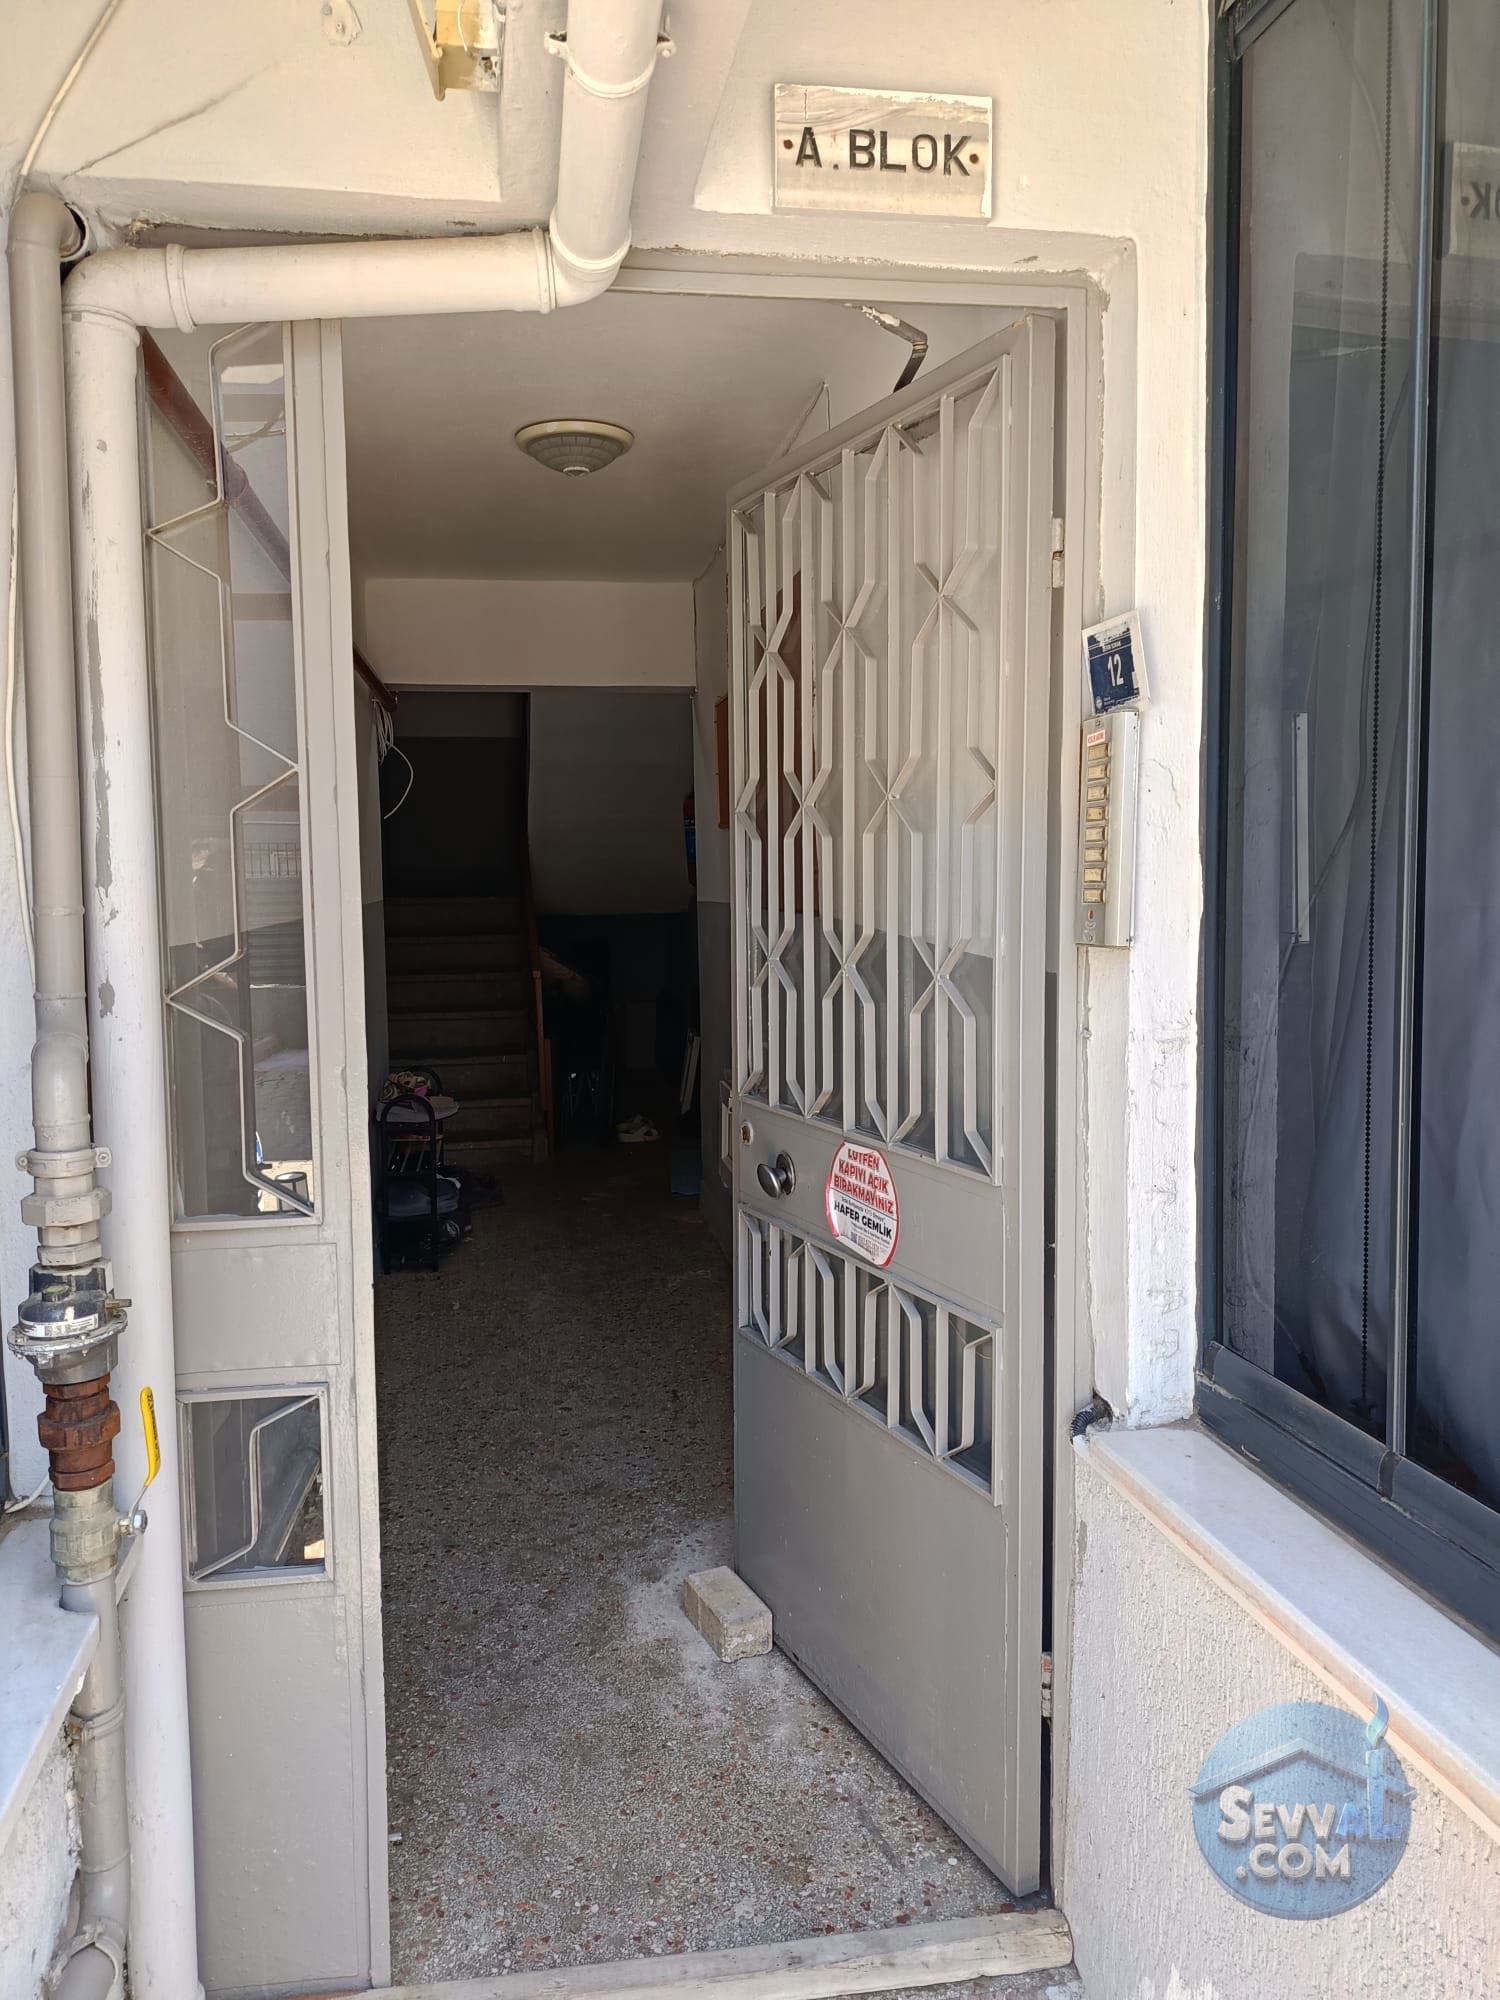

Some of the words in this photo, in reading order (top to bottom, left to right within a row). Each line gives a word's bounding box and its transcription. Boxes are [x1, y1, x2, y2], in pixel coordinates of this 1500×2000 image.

[1107, 653, 1124, 687] 12
[839, 1159, 866, 1185] KAPIYI
[834, 1199, 860, 1223] HAFER
[861, 1216, 892, 1239] GEMLİK
